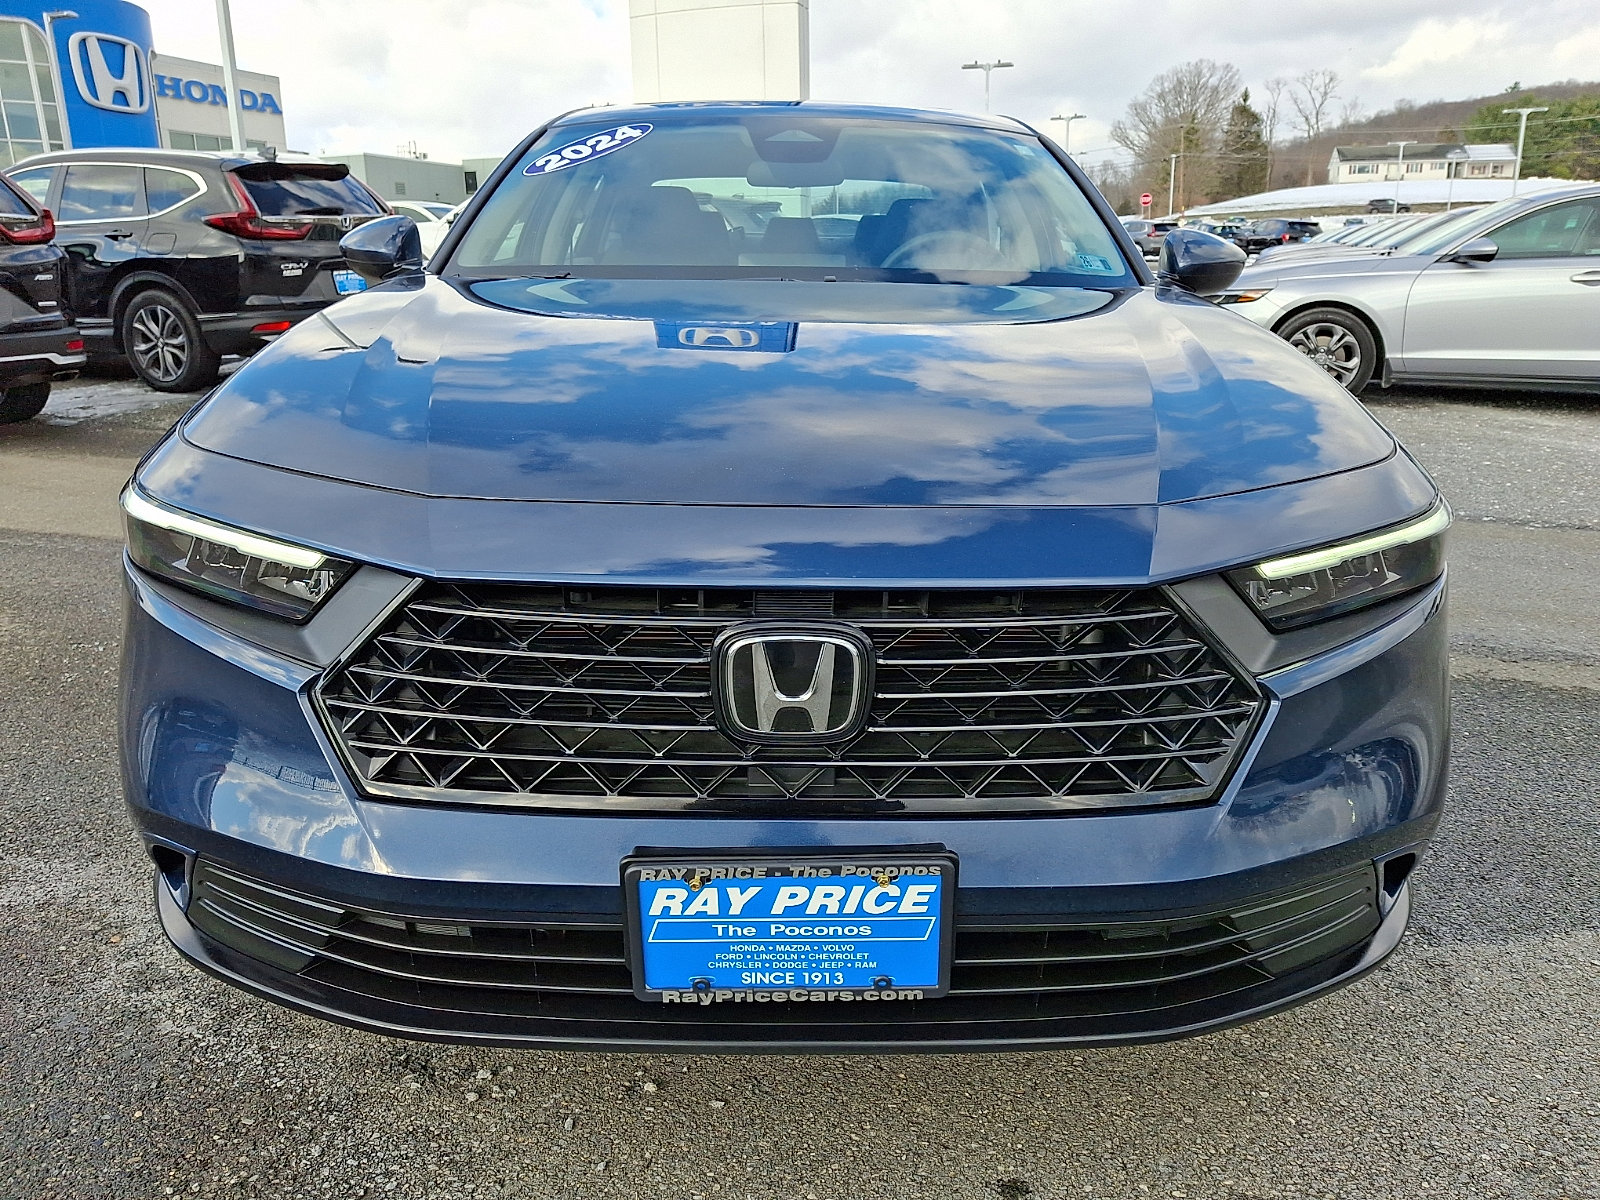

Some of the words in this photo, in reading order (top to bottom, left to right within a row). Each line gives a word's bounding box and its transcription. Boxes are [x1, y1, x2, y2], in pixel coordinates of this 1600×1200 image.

[154, 73, 283, 115] HONDA
[535, 126, 643, 172] 2024
[640, 867, 687, 882] RAY
[695, 866, 768, 880] PRICE
[790, 865, 832, 878] The
[841, 865, 941, 877] Poconos
[648, 887, 764, 916] RAY
[770, 885, 938, 915] PRICE
[712, 924, 757, 936] The
[770, 924, 872, 936] Poconos
[776, 944, 811, 952] MAZDA
[822, 944, 855, 952] VOLVO
[708, 961, 762, 969] CHRYSLER
[772, 961, 808, 969] DODGE
[819, 961, 844, 969] JEEP
[854, 961, 877, 969] RAM
[741, 972, 795, 985] SINCE
[803, 972, 844, 985] 1913
[662, 989, 924, 1006] RayPriceCars.com
